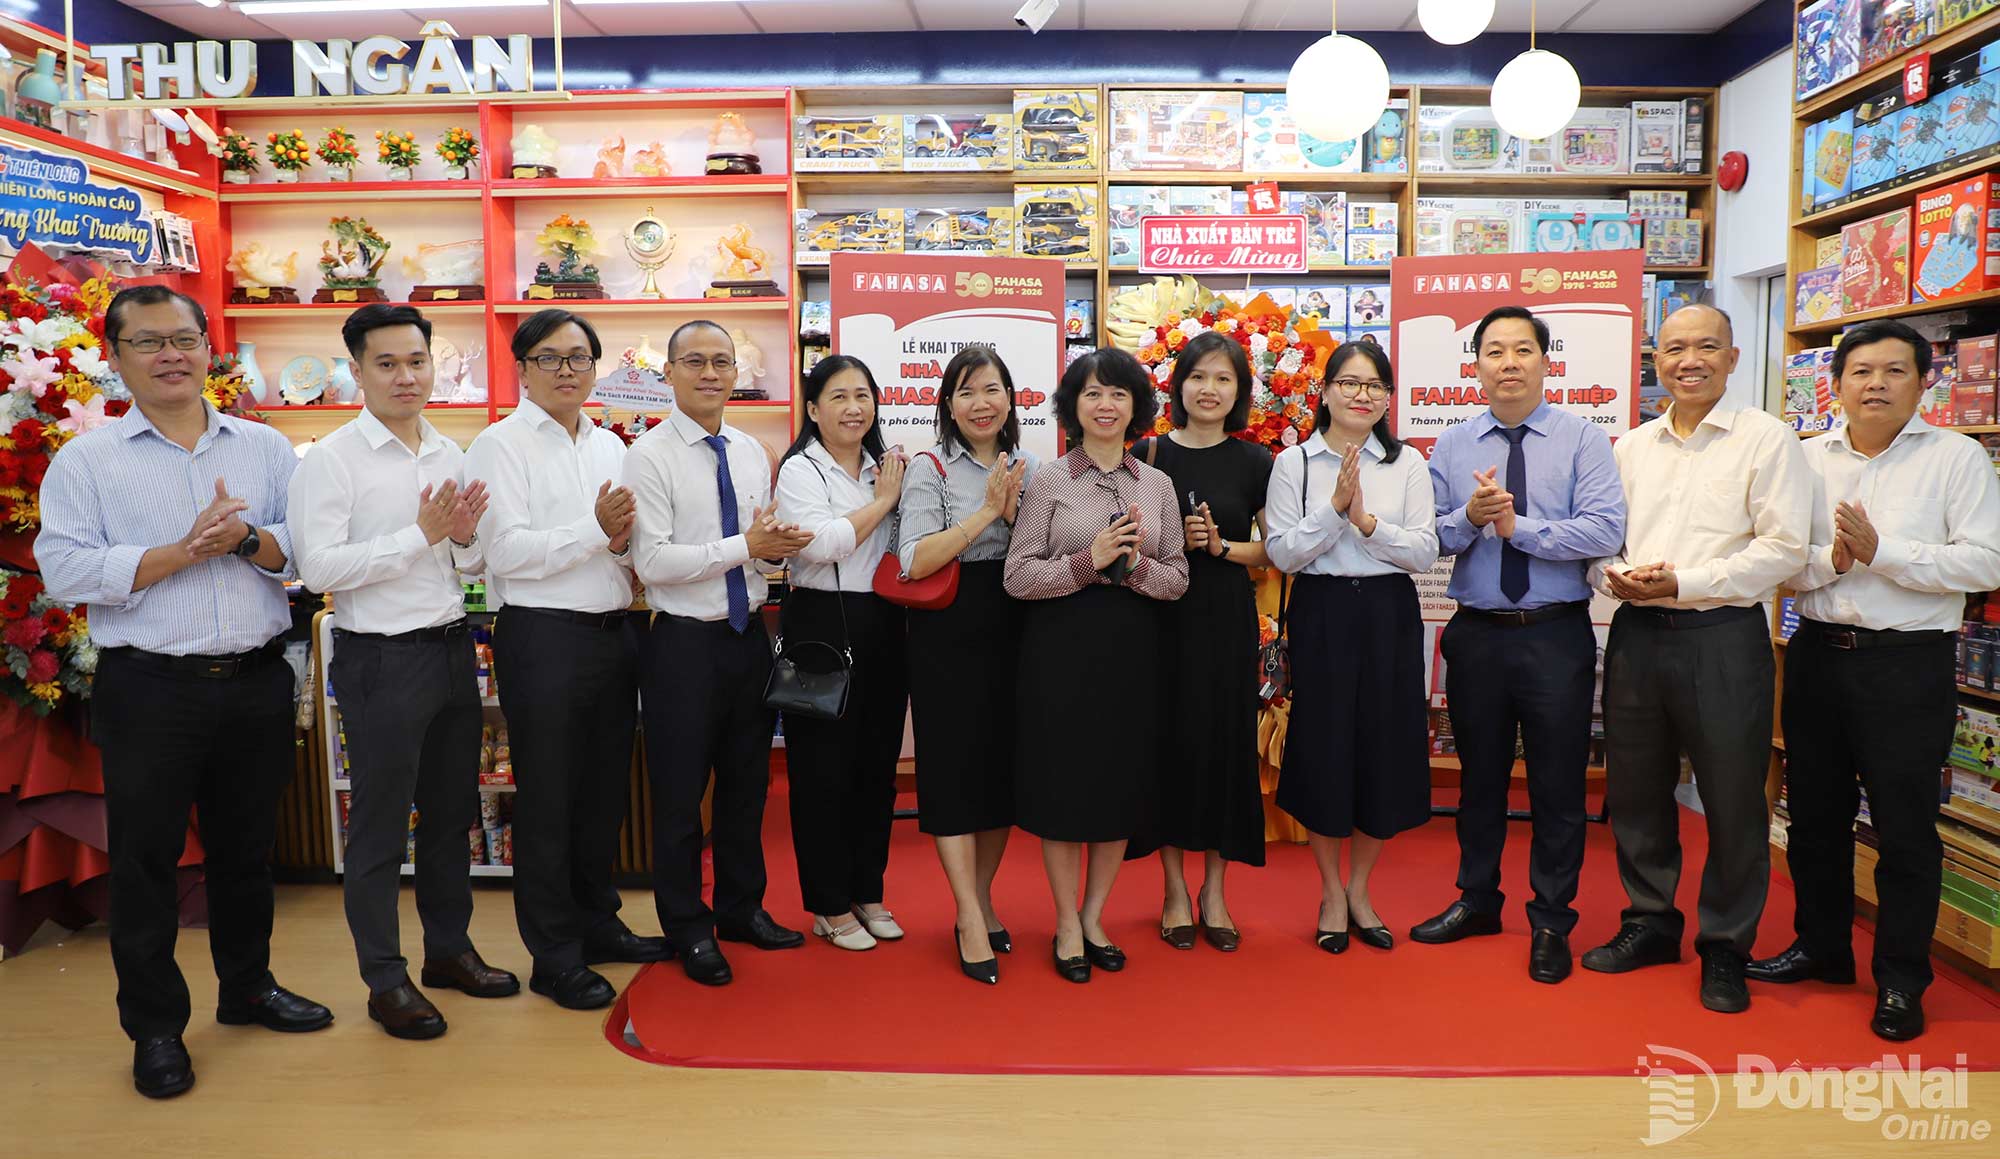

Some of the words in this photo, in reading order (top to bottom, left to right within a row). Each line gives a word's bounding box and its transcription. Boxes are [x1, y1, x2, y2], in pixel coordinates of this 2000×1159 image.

[90, 40, 257, 99] THU
[293, 20, 534, 97] NGÂN
[29, 187, 66, 202] LONG
[69, 192, 107, 208] HOÀN
[1920, 193, 1953, 213] BINGO
[33, 208, 80, 236] Khai
[1920, 207, 1953, 226] LOTTO
[1151, 223, 1183, 245] NHÀ
[1186, 220, 1228, 245] XUẤT
[1231, 222, 1262, 245] BẢN
[1266, 222, 1296, 245] TRẺ
[1151, 247, 1215, 266] Chúc
[1220, 246, 1300, 269] Mừng
[853, 272, 947, 293] FAHASA
[955, 272, 993, 297] 50
[994, 277, 1043, 287] FAHASA
[1414, 273, 1511, 294] FAHASA
[1520, 267, 1562, 294] 50
[1563, 270, 1617, 281] FAHASA
[1563, 281, 1584, 290] 1976
[1593, 280, 1617, 289] 2026
[1021, 288, 1043, 296] 2026
[920, 341, 947, 354] KHAI
[900, 359, 945, 379] NHÀ
[1014, 387, 1046, 410] IỆP
[1411, 386, 1490, 406] FAHAS
[1568, 384, 1617, 408] HIỆP
[1411, 416, 1444, 425] Thành
